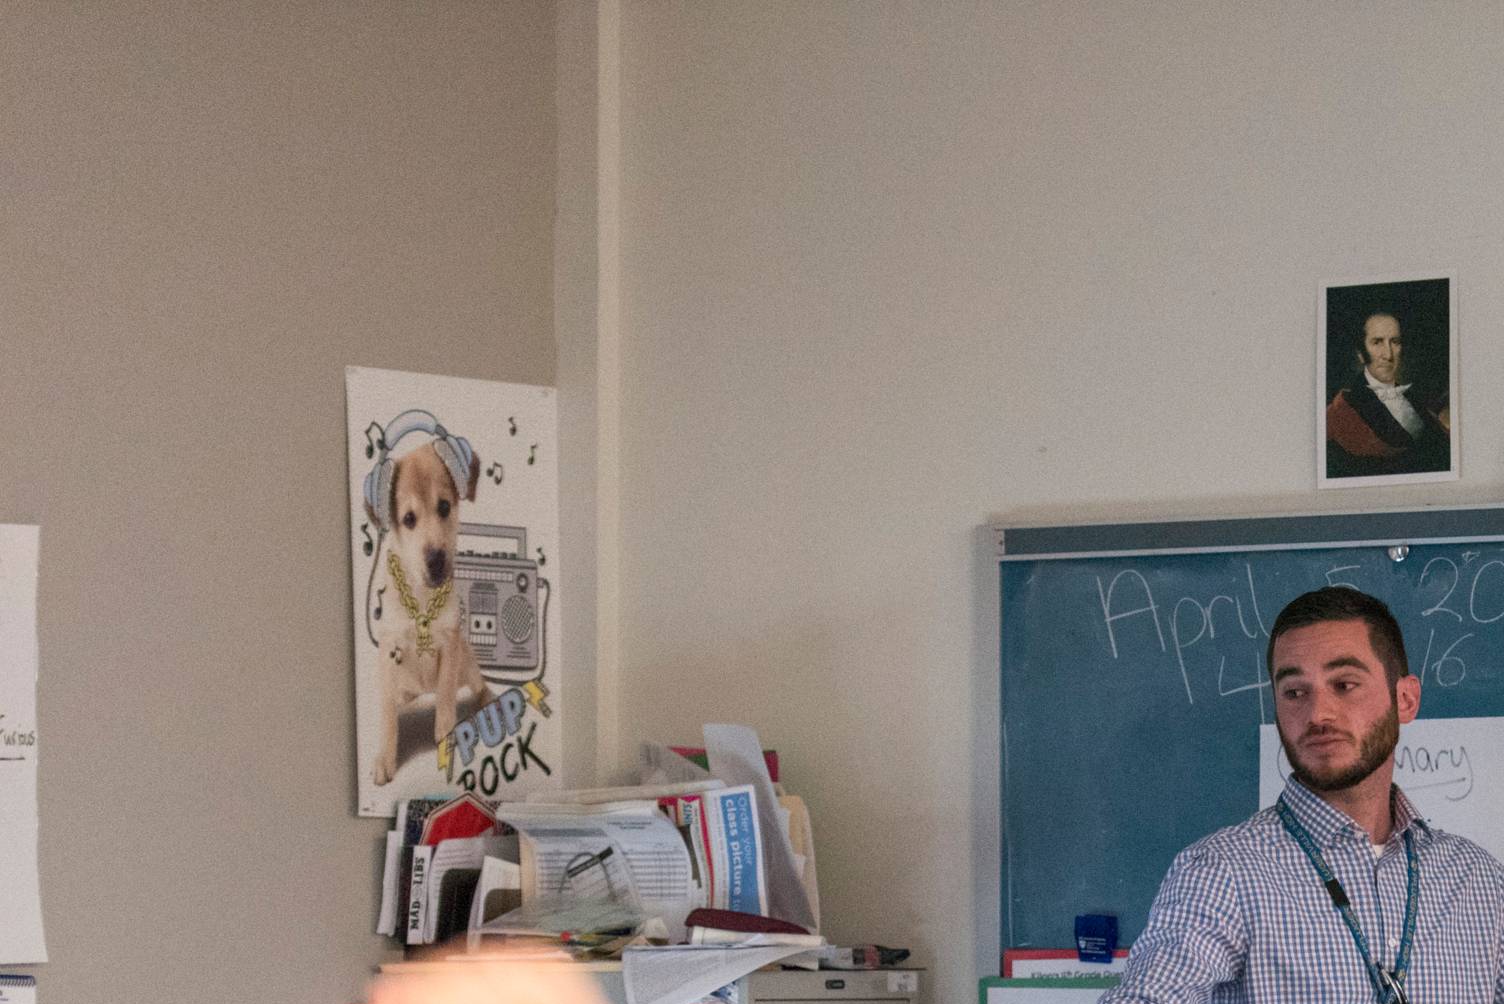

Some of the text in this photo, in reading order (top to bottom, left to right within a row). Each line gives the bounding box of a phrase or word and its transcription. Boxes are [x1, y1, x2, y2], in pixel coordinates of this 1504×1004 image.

[1096, 562, 1270, 704] April
[454, 687, 525, 766] PUP
[410, 857, 424, 930] MAD LIBS
